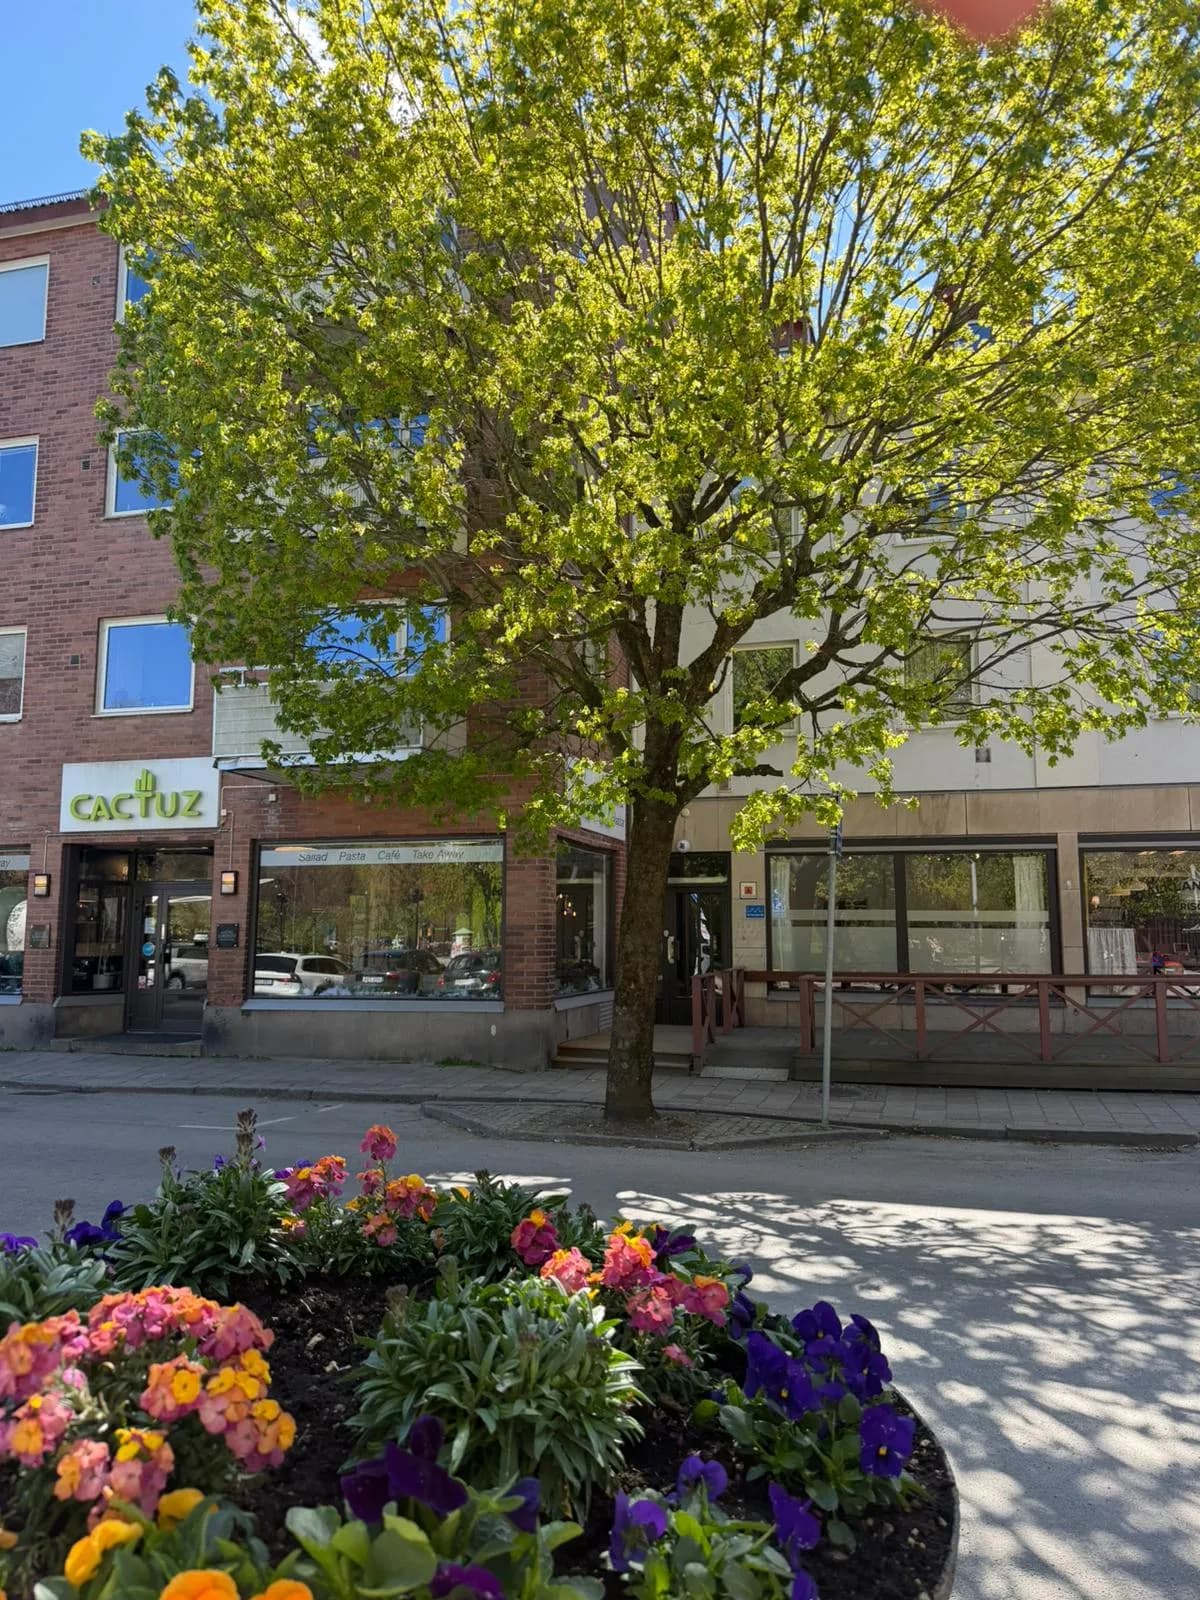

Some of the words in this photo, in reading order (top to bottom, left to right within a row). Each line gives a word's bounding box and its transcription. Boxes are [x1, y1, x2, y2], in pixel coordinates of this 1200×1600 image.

[70, 789, 202, 821] CACTUZ
[338, 850, 366, 861] Pasta
[377, 850, 400, 861] Café
[412, 849, 433, 860] Take
